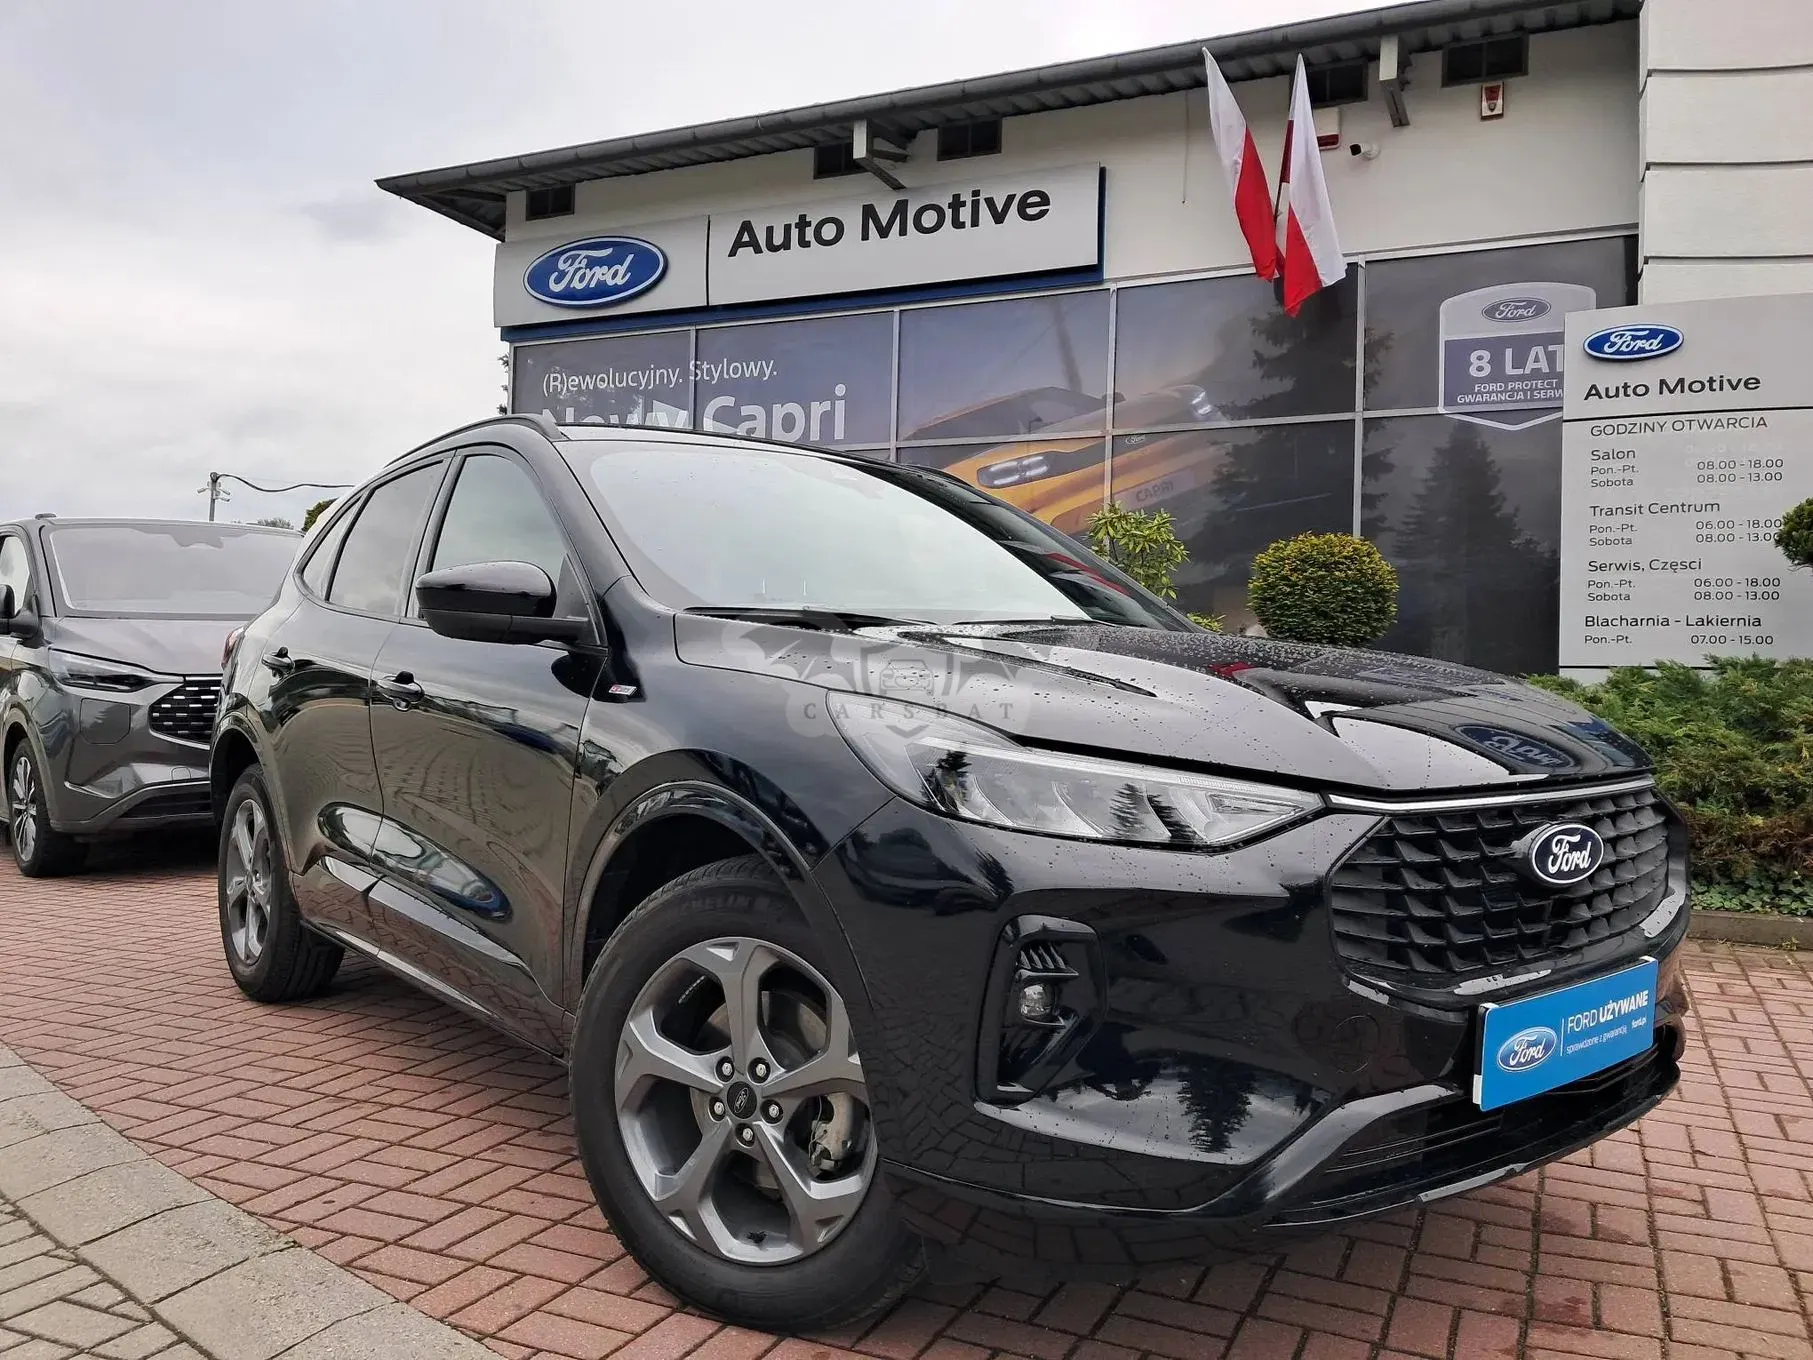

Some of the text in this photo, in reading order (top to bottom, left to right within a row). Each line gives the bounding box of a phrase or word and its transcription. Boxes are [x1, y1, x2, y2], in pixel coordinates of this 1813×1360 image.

[727, 188, 1051, 258] Auto Motive
[548, 247, 632, 292] Ford
[1495, 302, 1536, 318] Ford
[1604, 330, 1664, 353] Ford
[1469, 344, 1563, 377] 8 LAT
[543, 359, 777, 396] (R)ewolucyjny. Stylowy.
[1475, 379, 1558, 393] FORD PROTECT
[1584, 375, 1761, 401] Auto Motive
[1457, 390, 1524, 403] GWARANCJA
[1527, 391, 1531, 399] I
[703, 383, 846, 442] Capri
[1590, 416, 1768, 437] GODZINY OTWARCIA
[1590, 449, 1636, 461] Salon
[1590, 464, 1639, 475] Pon.-Pt.
[1697, 460, 1737, 470] 08.00
[1749, 458, 1784, 469] 18.00
[1590, 478, 1633, 488] Sobota
[1697, 474, 1737, 484] 08.00
[1748, 471, 1783, 482] 13.00
[1590, 502, 1721, 517] Transit Centrum
[1589, 523, 1638, 534] Pon.-Pt.
[1696, 520, 1735, 530] 06.00
[1746, 519, 1782, 529] 18.00
[1589, 536, 1633, 547] Sobota
[1696, 533, 1735, 543] 08.00
[1588, 559, 1645, 572] Serwis,
[1587, 579, 1636, 589] Pon.-Pt.
[1694, 578, 1733, 588] 06.00
[1745, 577, 1781, 588] 18.00
[1587, 592, 1631, 602] Sobota
[1694, 591, 1733, 601] 08.00
[1745, 590, 1780, 601] 13.00
[1584, 614, 1670, 627] Blacharnia
[1685, 614, 1762, 627] Lakiernia
[1584, 634, 1632, 645] Pon.-Pt.
[1690, 635, 1727, 645] 07.00
[1739, 635, 1774, 645] 15.00
[1548, 834, 1592, 874] Ford
[1567, 990, 1649, 1033] FORD UŻYWANE
[1509, 1034, 1546, 1066] Ford
